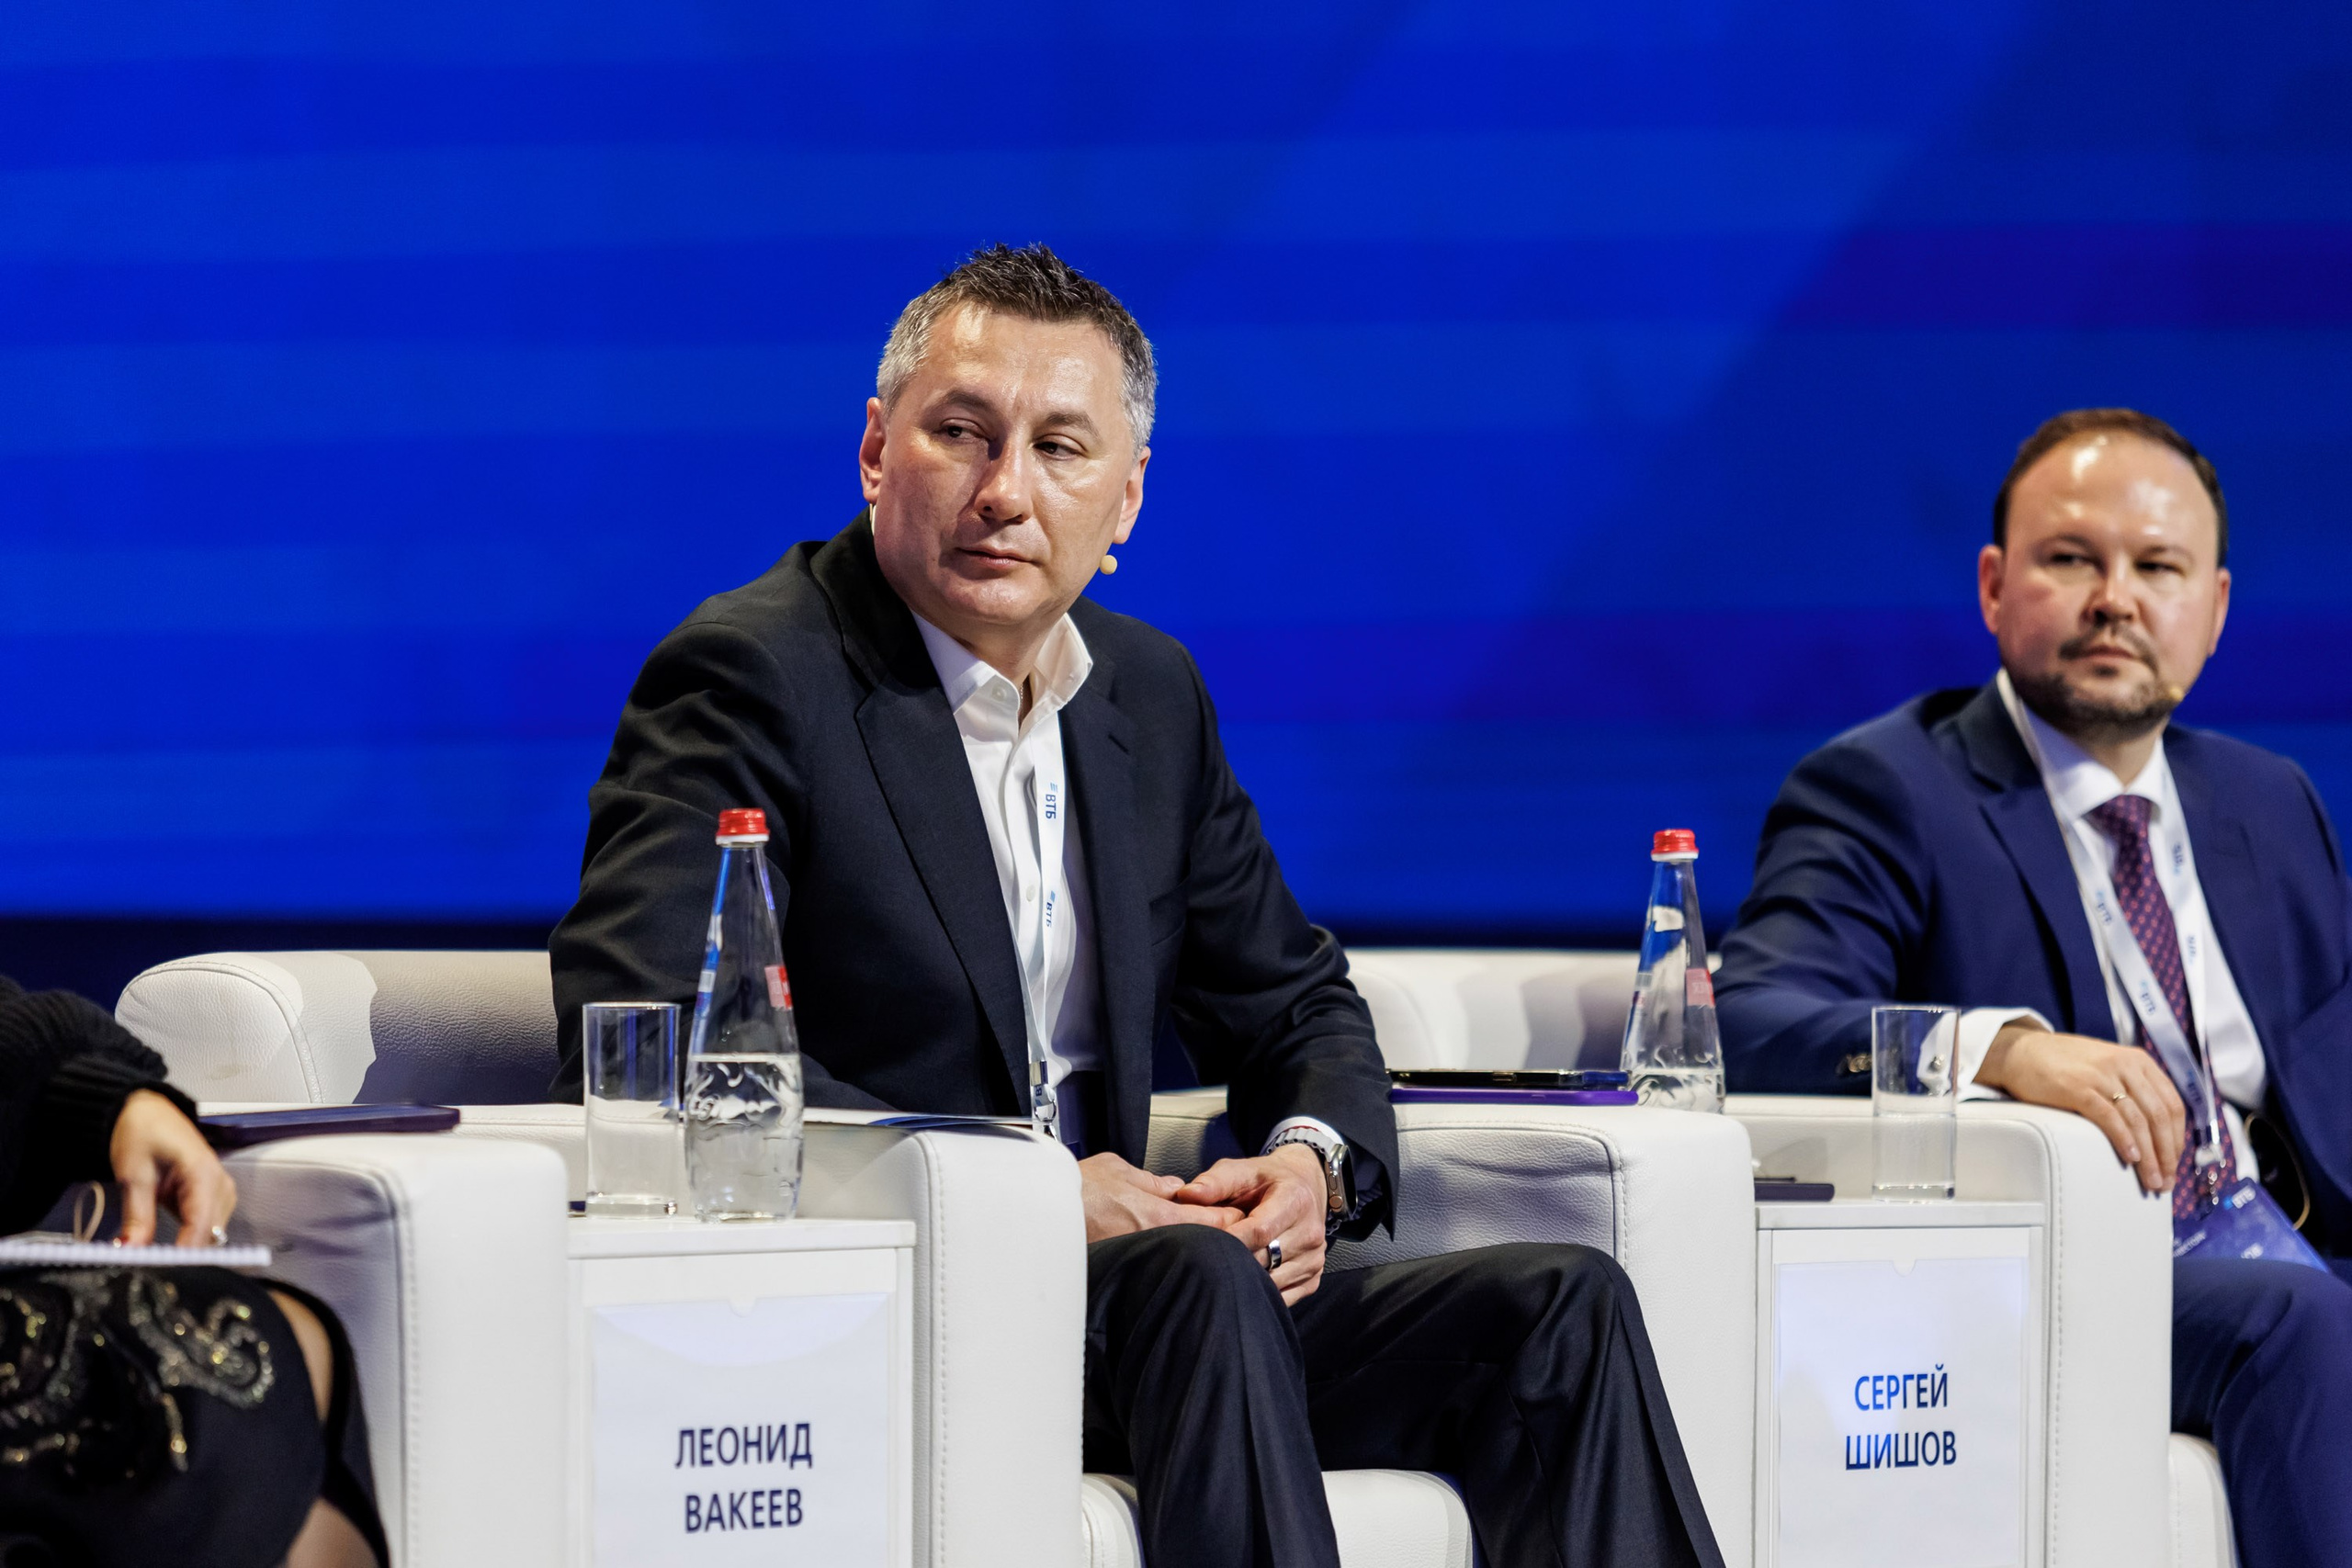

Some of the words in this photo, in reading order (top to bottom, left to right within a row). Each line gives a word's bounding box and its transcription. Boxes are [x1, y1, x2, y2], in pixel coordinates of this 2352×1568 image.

[1046, 794, 1057, 819] ВТБ
[1854, 1363, 1948, 1411] СЕРГЕЙ
[674, 1422, 813, 1470] ЛЕОНИД
[1845, 1430, 1957, 1471] ШИШОВ
[685, 1488, 804, 1534] ВАКЕЕВ
